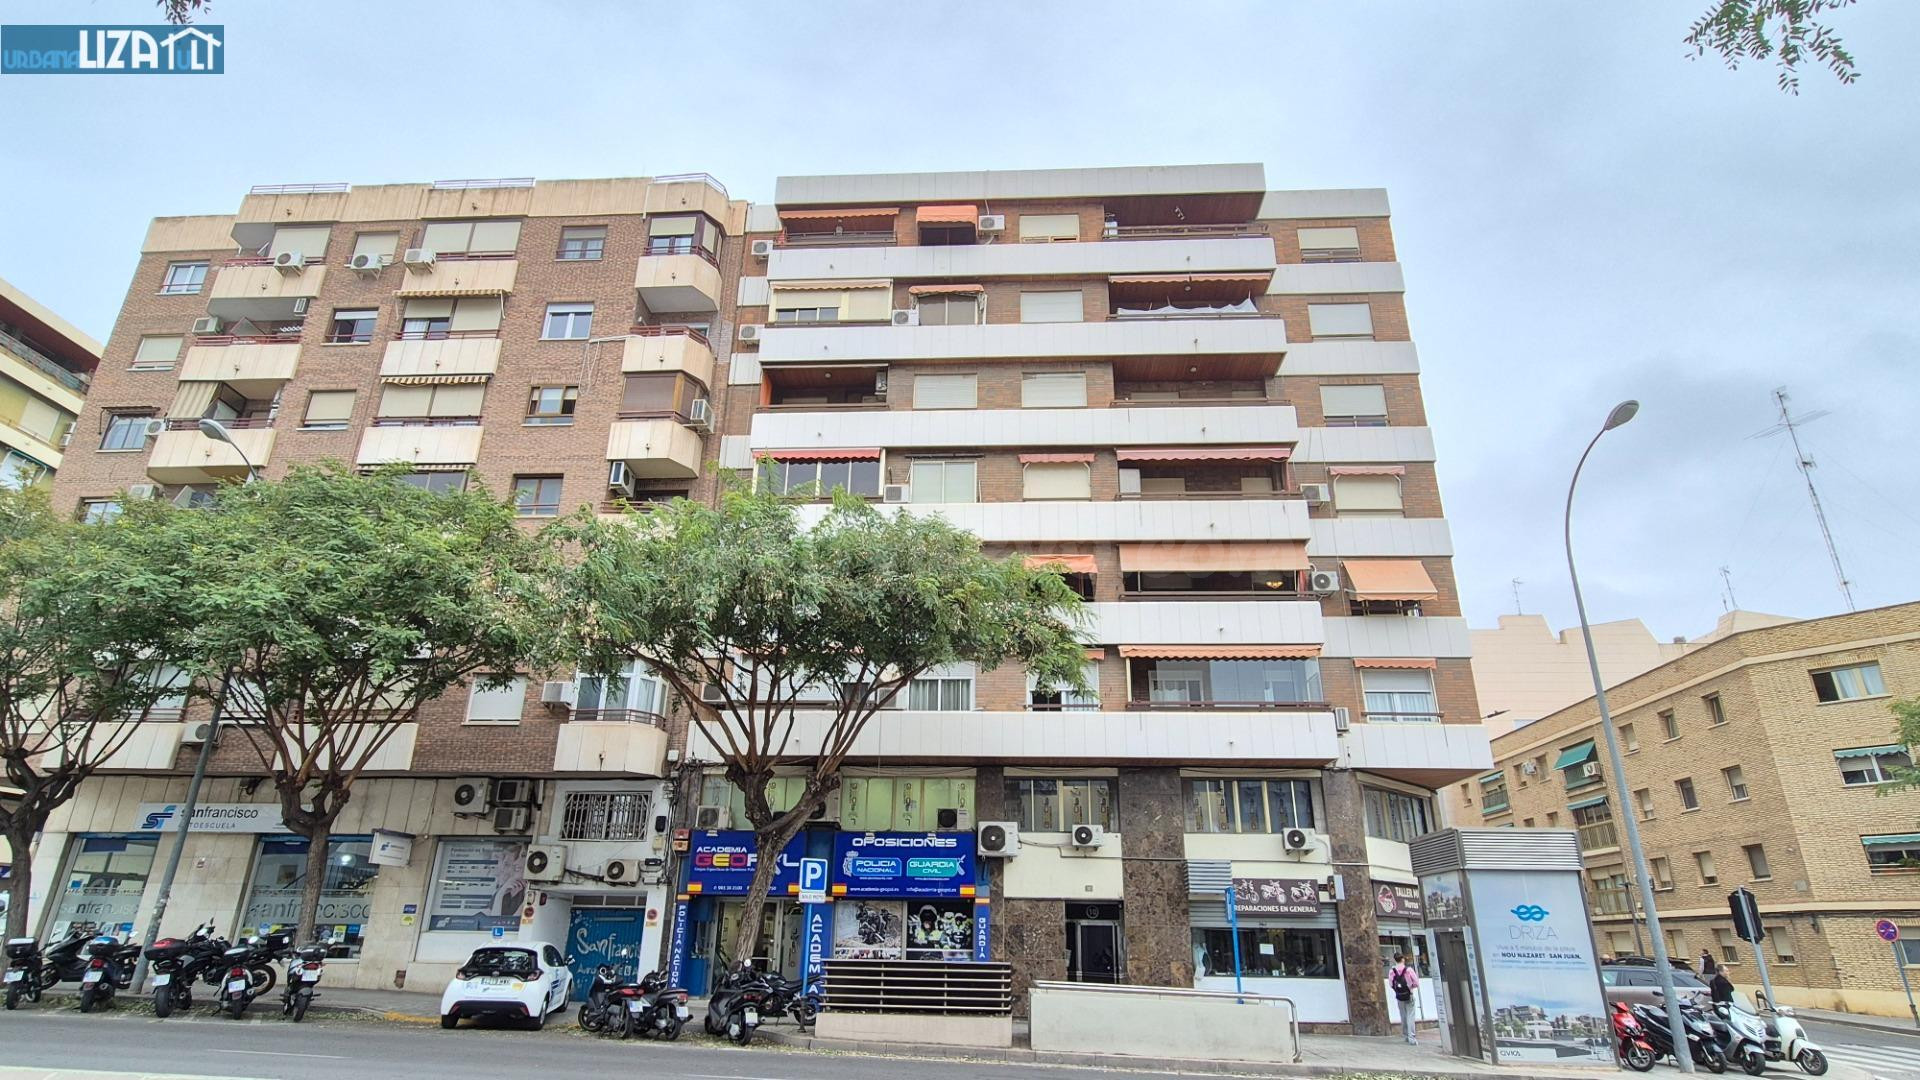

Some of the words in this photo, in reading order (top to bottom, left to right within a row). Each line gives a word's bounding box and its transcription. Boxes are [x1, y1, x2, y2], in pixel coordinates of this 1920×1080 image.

[696, 846, 748, 854] ACADEMIA
[852, 837, 958, 848] OPOSICIONES
[695, 853, 800, 867] GEOPL
[805, 862, 823, 888] P
[1396, 887, 1413, 898] TALLER
[1234, 904, 1280, 912] REPARACIONES
[675, 905, 686, 945] POLICIA
[1508, 925, 1559, 940] DRIZA
[978, 917, 987, 958] GUARDIA
[808, 913, 823, 994] ACADEMA
[671, 948, 681, 988] NACIONA
